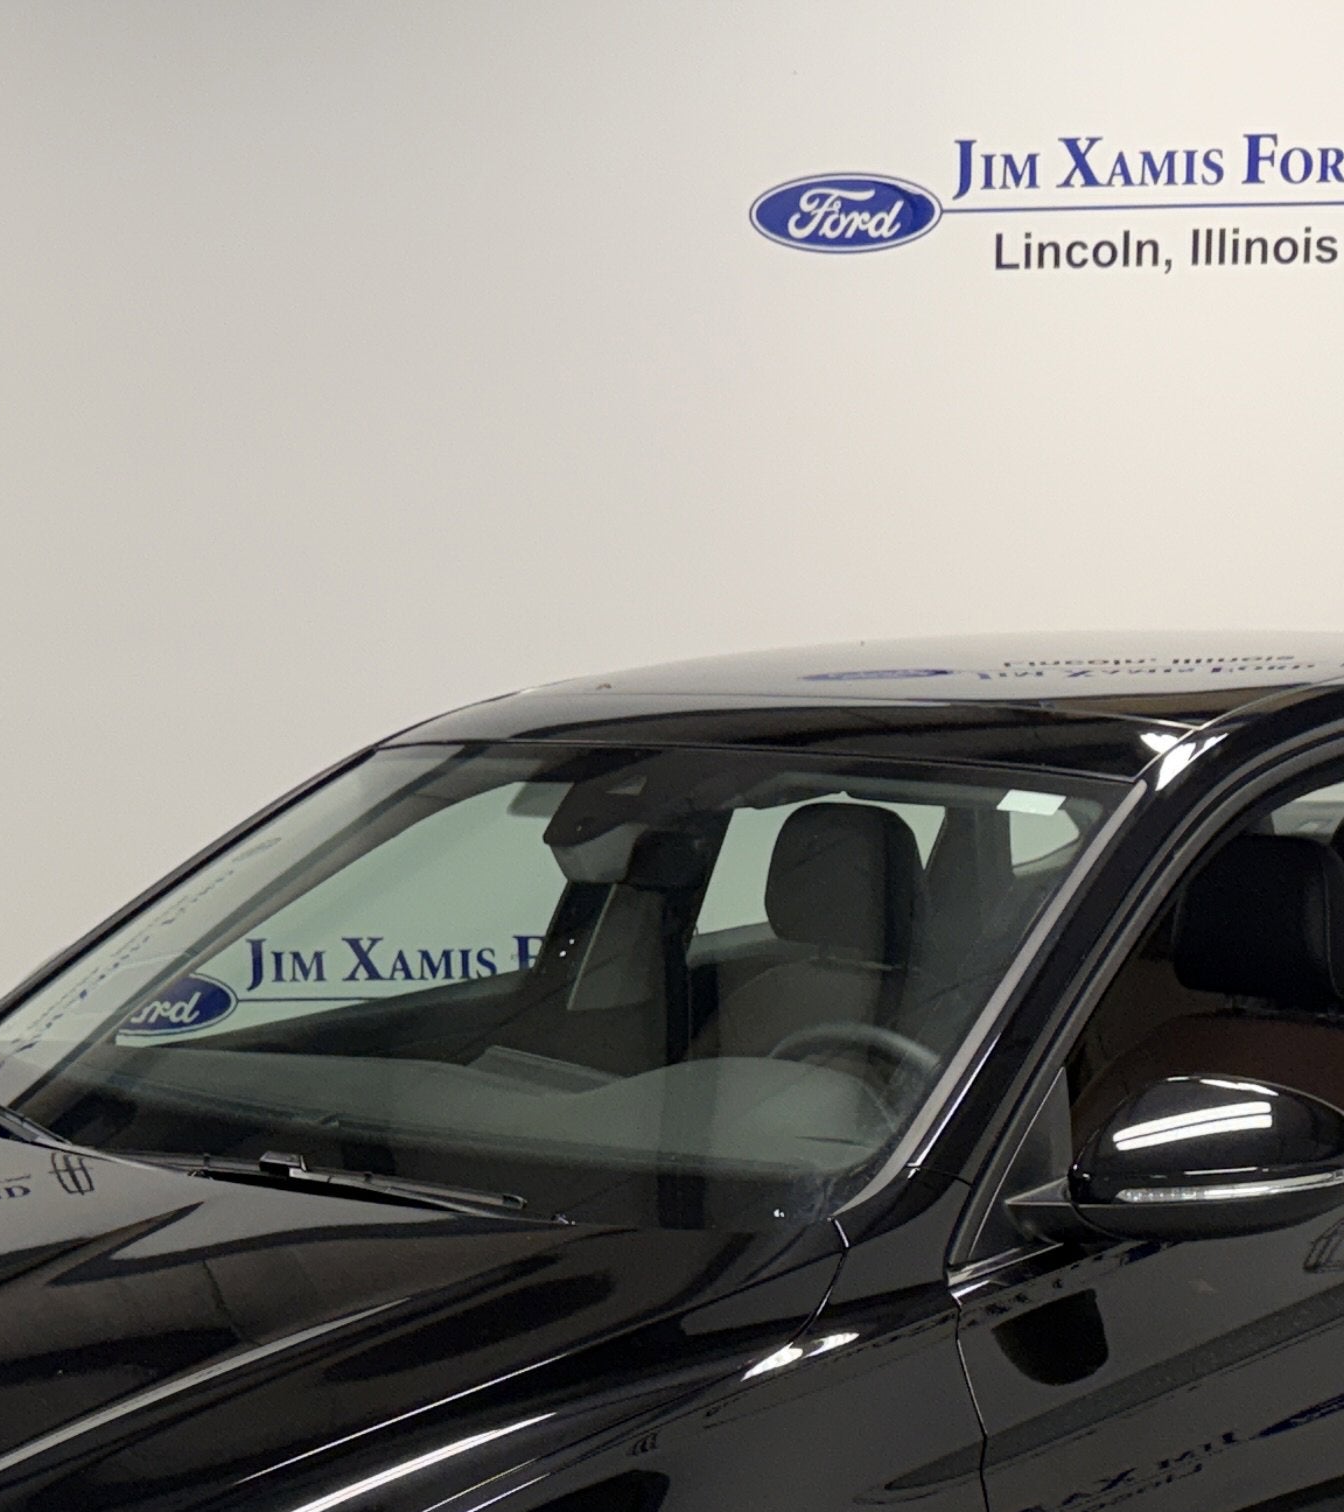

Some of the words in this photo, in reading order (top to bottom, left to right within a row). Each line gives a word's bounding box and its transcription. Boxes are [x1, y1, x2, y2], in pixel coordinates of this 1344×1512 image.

[952, 138, 1041, 200] JIM
[1057, 135, 1225, 191] XAMIS
[787, 187, 902, 240] Ford
[993, 230, 1174, 275] Lincoln,
[1190, 226, 1340, 267] Illinois
[245, 937, 328, 992] JIM
[341, 935, 497, 983] XAMIS
[130, 991, 202, 1024] ord
